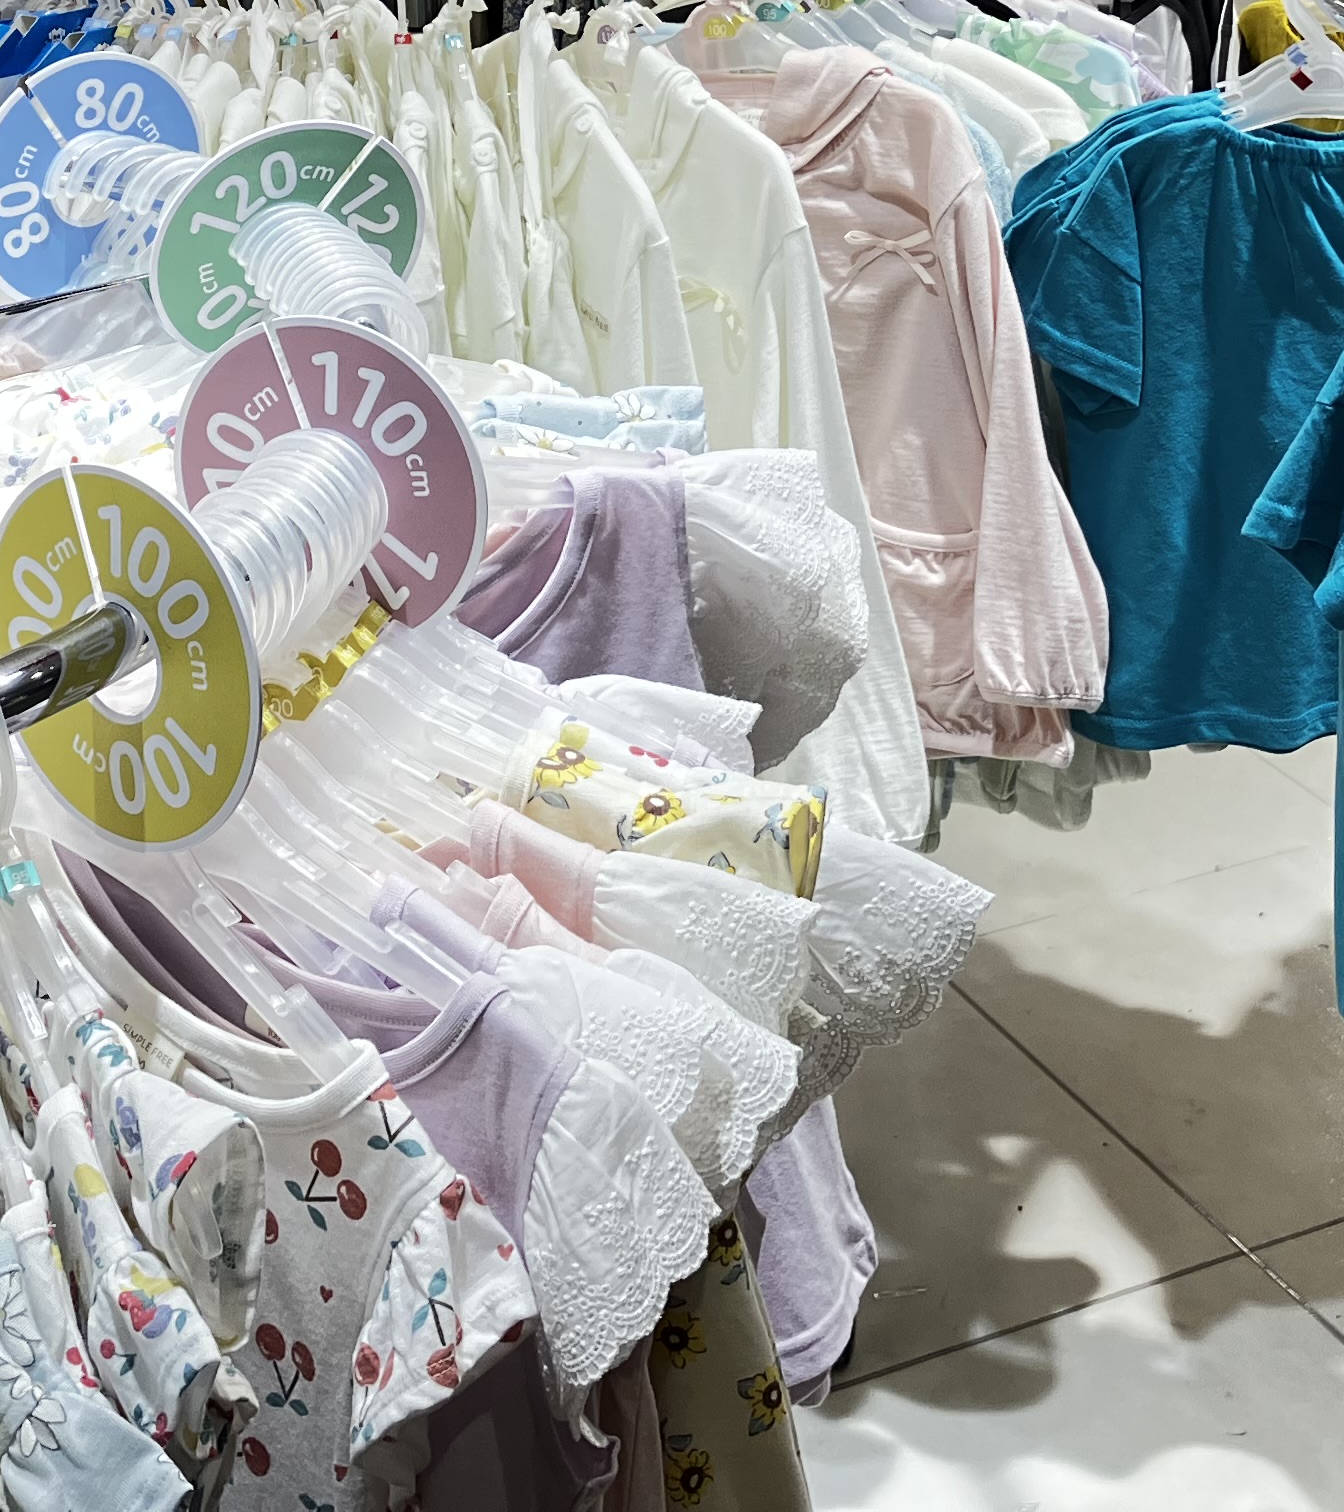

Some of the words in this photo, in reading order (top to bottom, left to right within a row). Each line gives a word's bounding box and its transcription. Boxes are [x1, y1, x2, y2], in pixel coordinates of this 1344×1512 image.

[708, 23, 728, 36] 100
[75, 77, 160, 144] 80cm
[190, 150, 335, 237] 120cm
[311, 351, 431, 497] 110cm
[97, 504, 210, 693] 100cm
